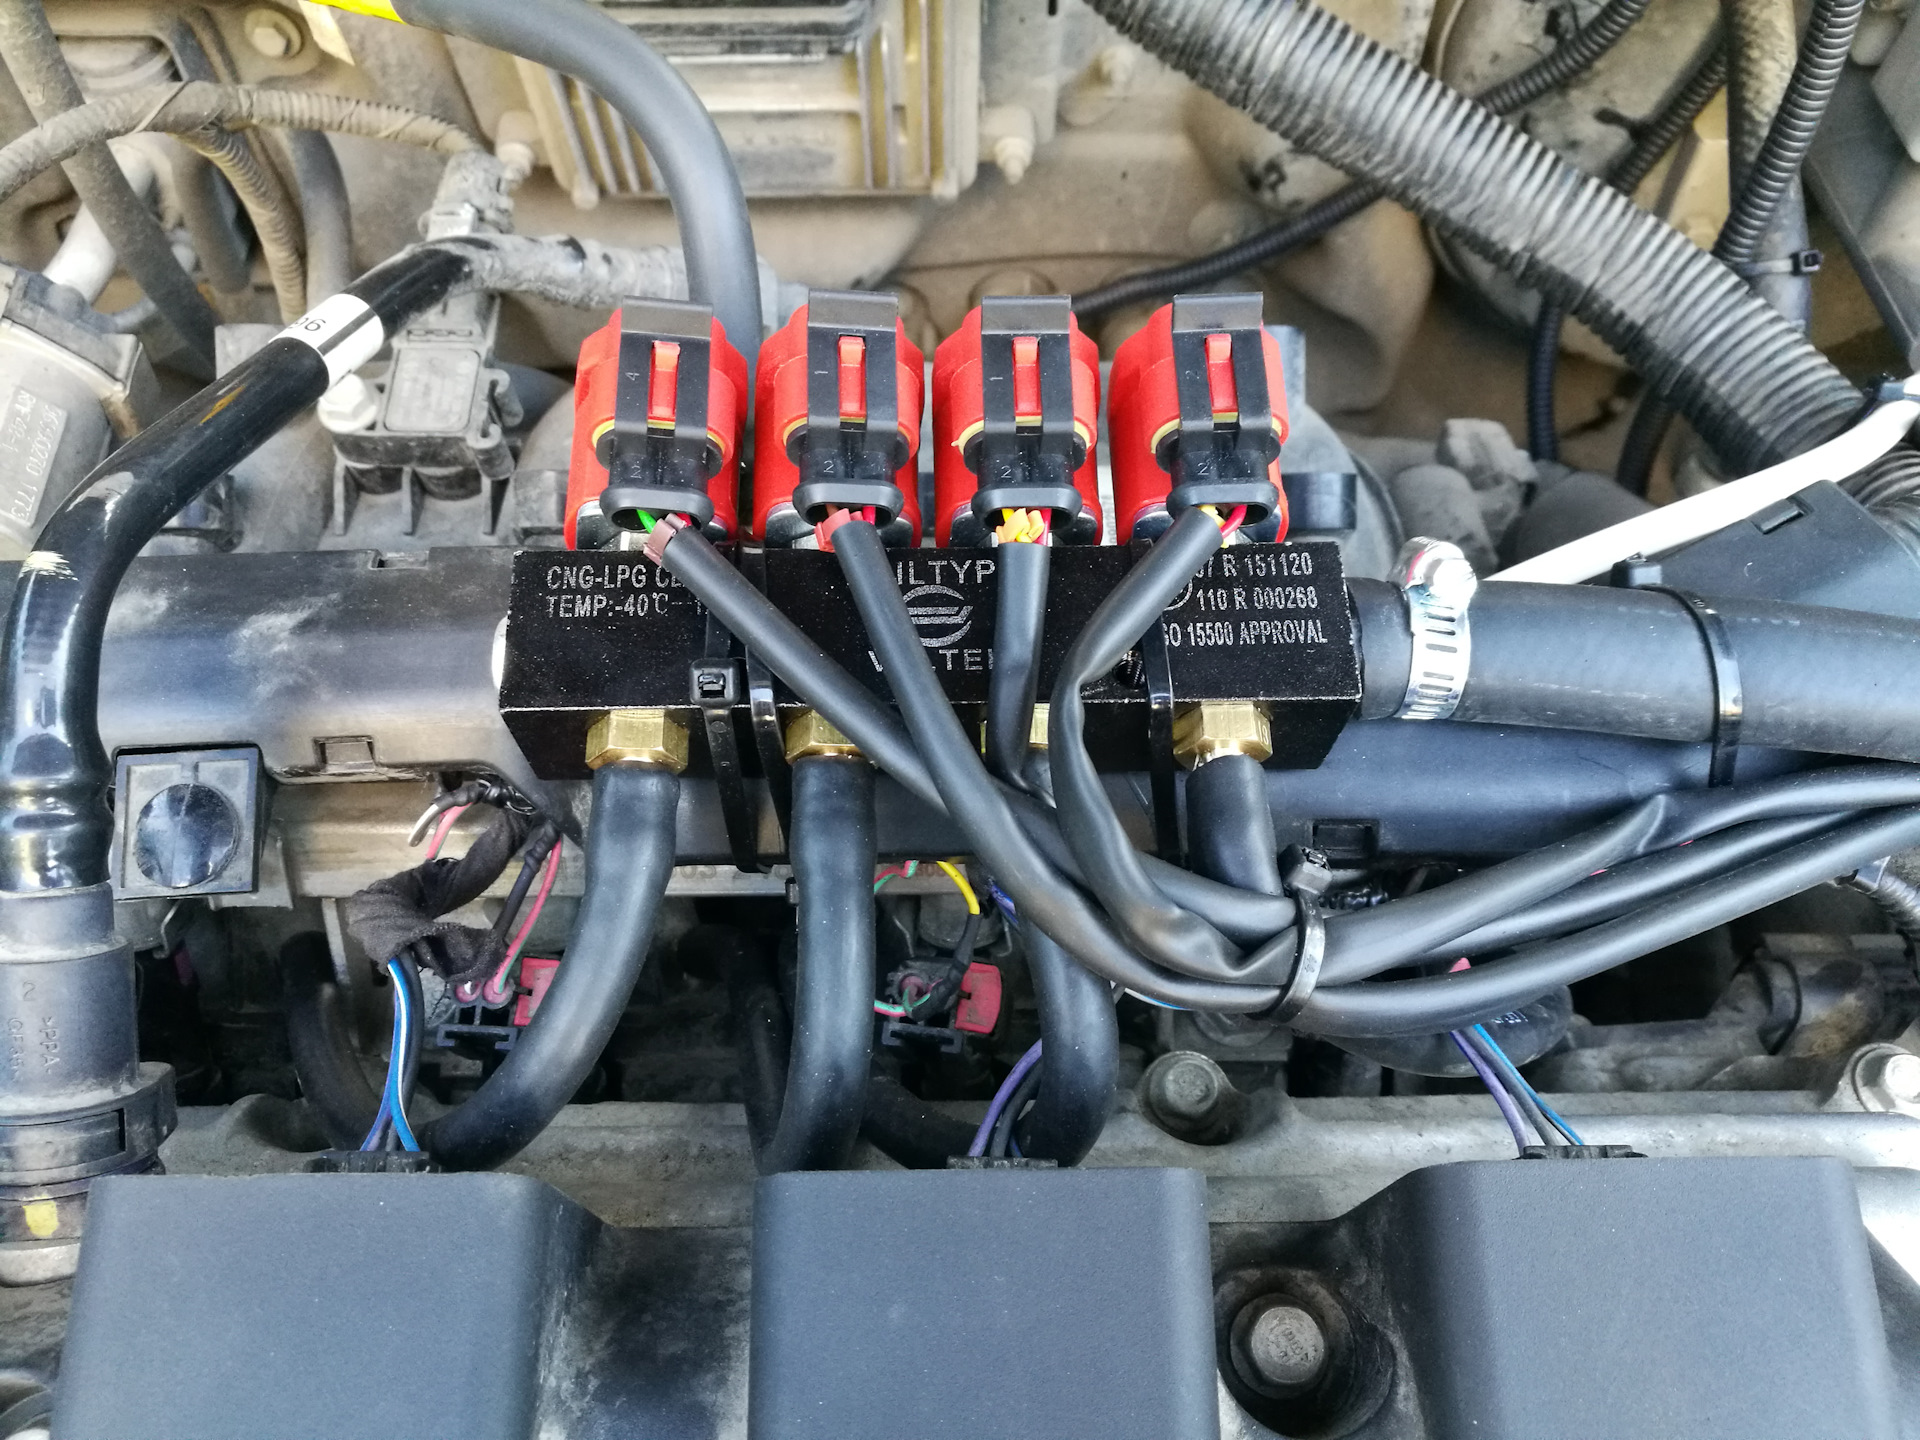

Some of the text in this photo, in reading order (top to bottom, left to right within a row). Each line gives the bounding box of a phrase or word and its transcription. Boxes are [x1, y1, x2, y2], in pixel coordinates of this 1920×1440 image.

[630, 464, 642, 479] 2
[823, 460, 835, 474] 2
[1001, 464, 1012, 479] 2
[1197, 462, 1210, 476] 2
[1222, 553, 1238, 577] R
[1244, 552, 1314, 577] 151120
[546, 564, 648, 589] CNG-LPG
[1197, 585, 1318, 611] 110 R 000268
[1187, 621, 1233, 647] 15500
[1239, 619, 1328, 645] APPROVAL
